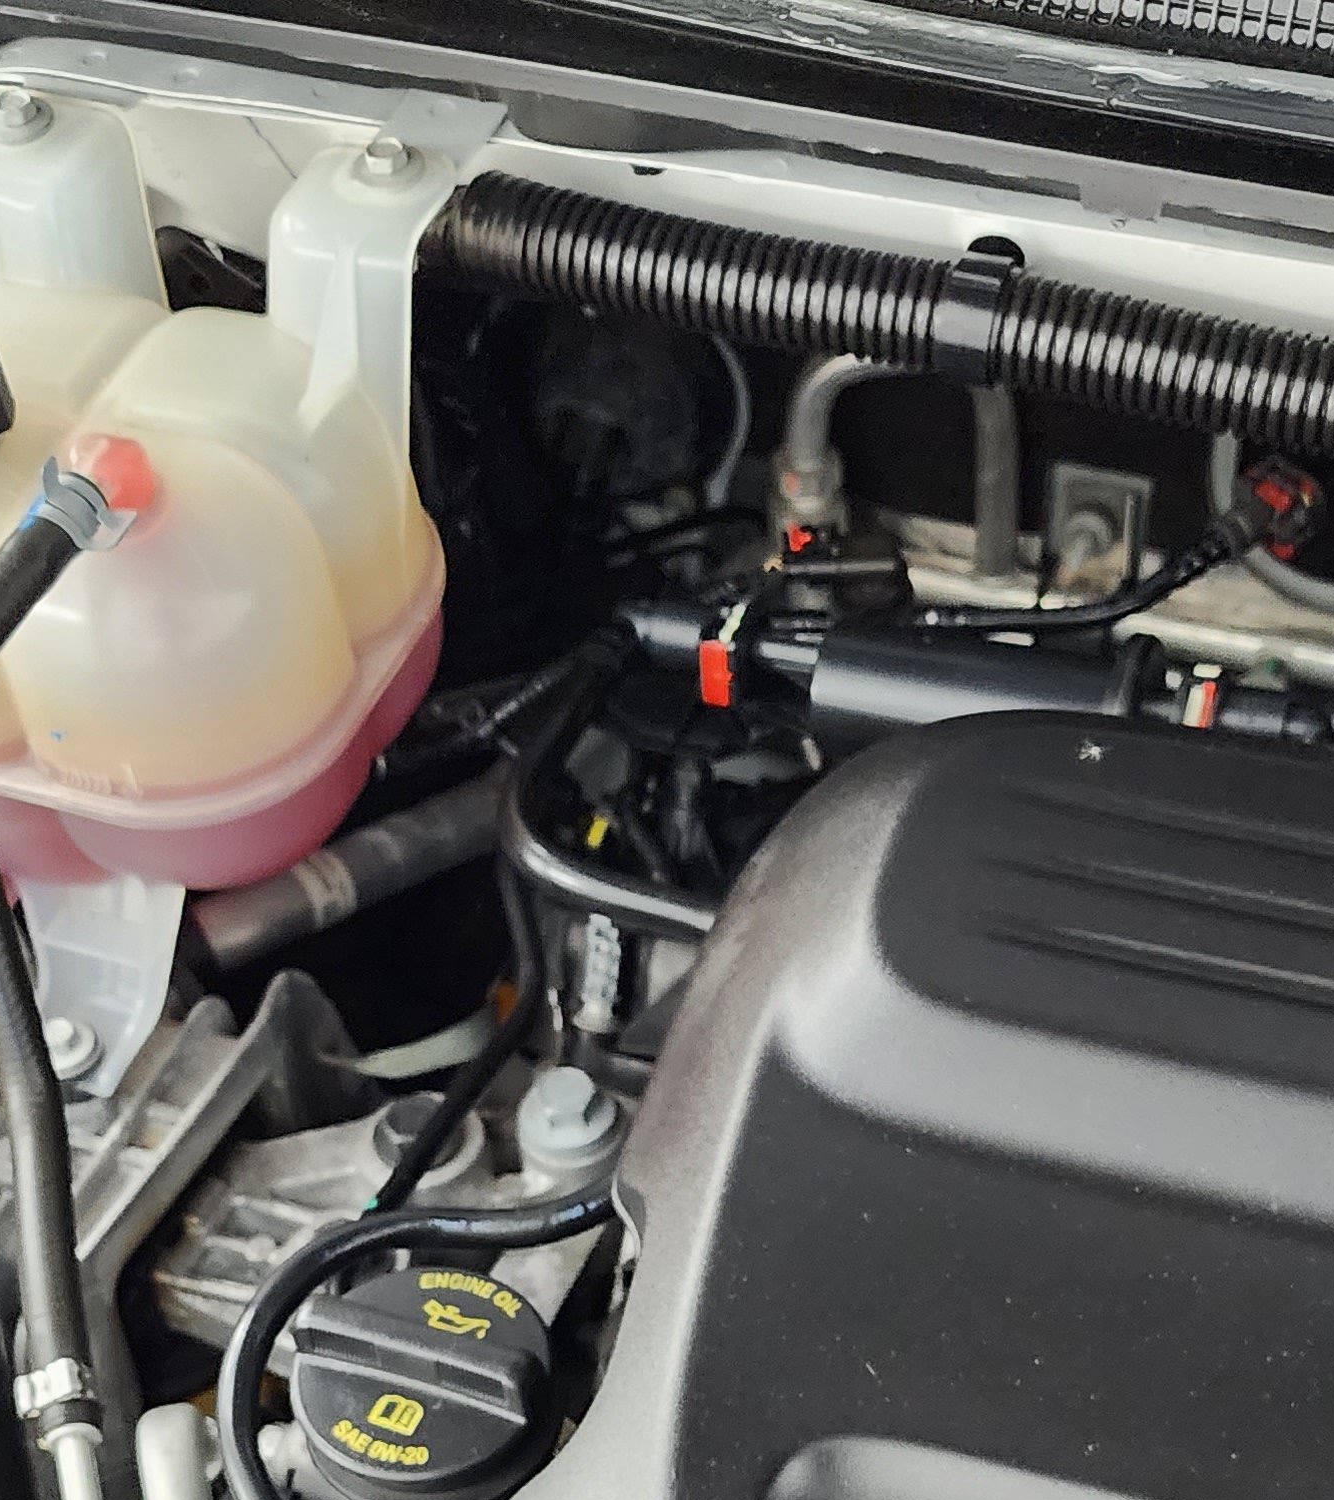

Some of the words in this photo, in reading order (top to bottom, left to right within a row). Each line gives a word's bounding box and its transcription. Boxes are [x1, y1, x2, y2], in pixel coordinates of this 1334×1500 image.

[419, 1272, 498, 1299] ENGINE
[492, 1289, 523, 1319] OIL
[331, 1419, 373, 1453] SAE
[367, 1439, 429, 1466] 0W-20
